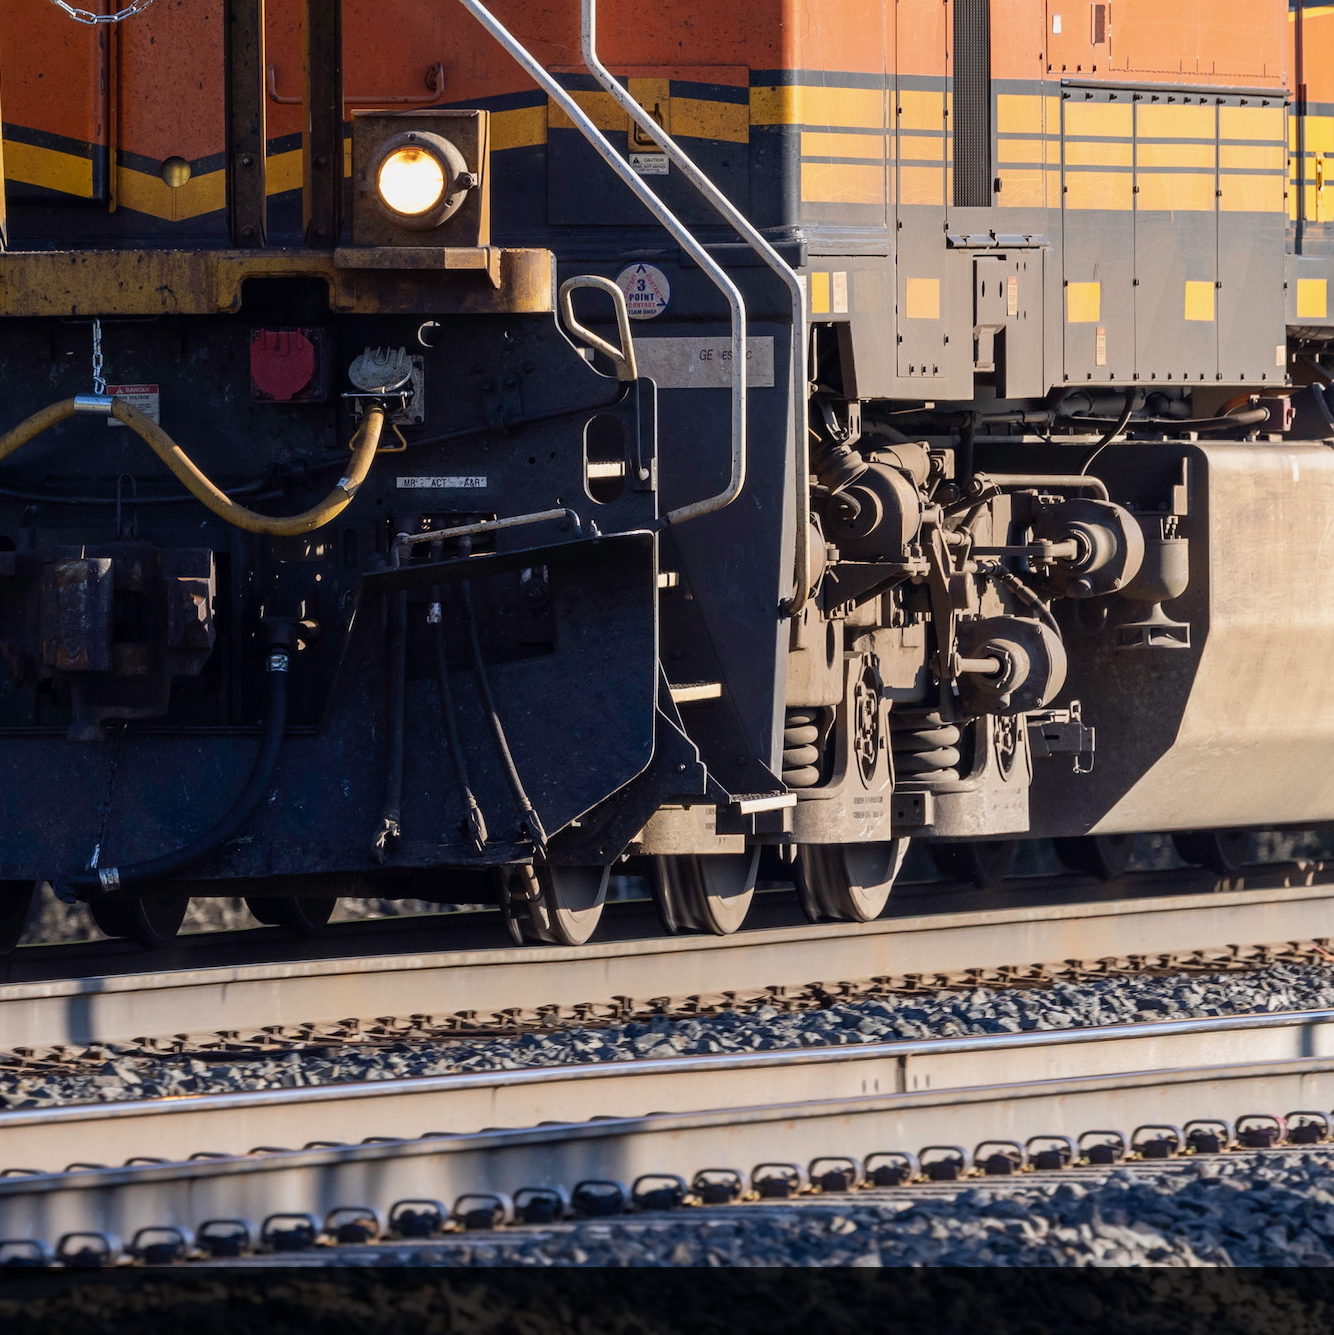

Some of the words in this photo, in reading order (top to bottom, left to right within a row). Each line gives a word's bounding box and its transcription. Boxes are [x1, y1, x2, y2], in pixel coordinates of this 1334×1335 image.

[637, 278, 646, 292] 3
[645, 273, 663, 298] CONTACT
[629, 293, 654, 301] POINT
[699, 349, 714, 361] GE
[403, 478, 416, 487] MR
[431, 478, 447, 487] ACT
[464, 478, 480, 487] A&R
